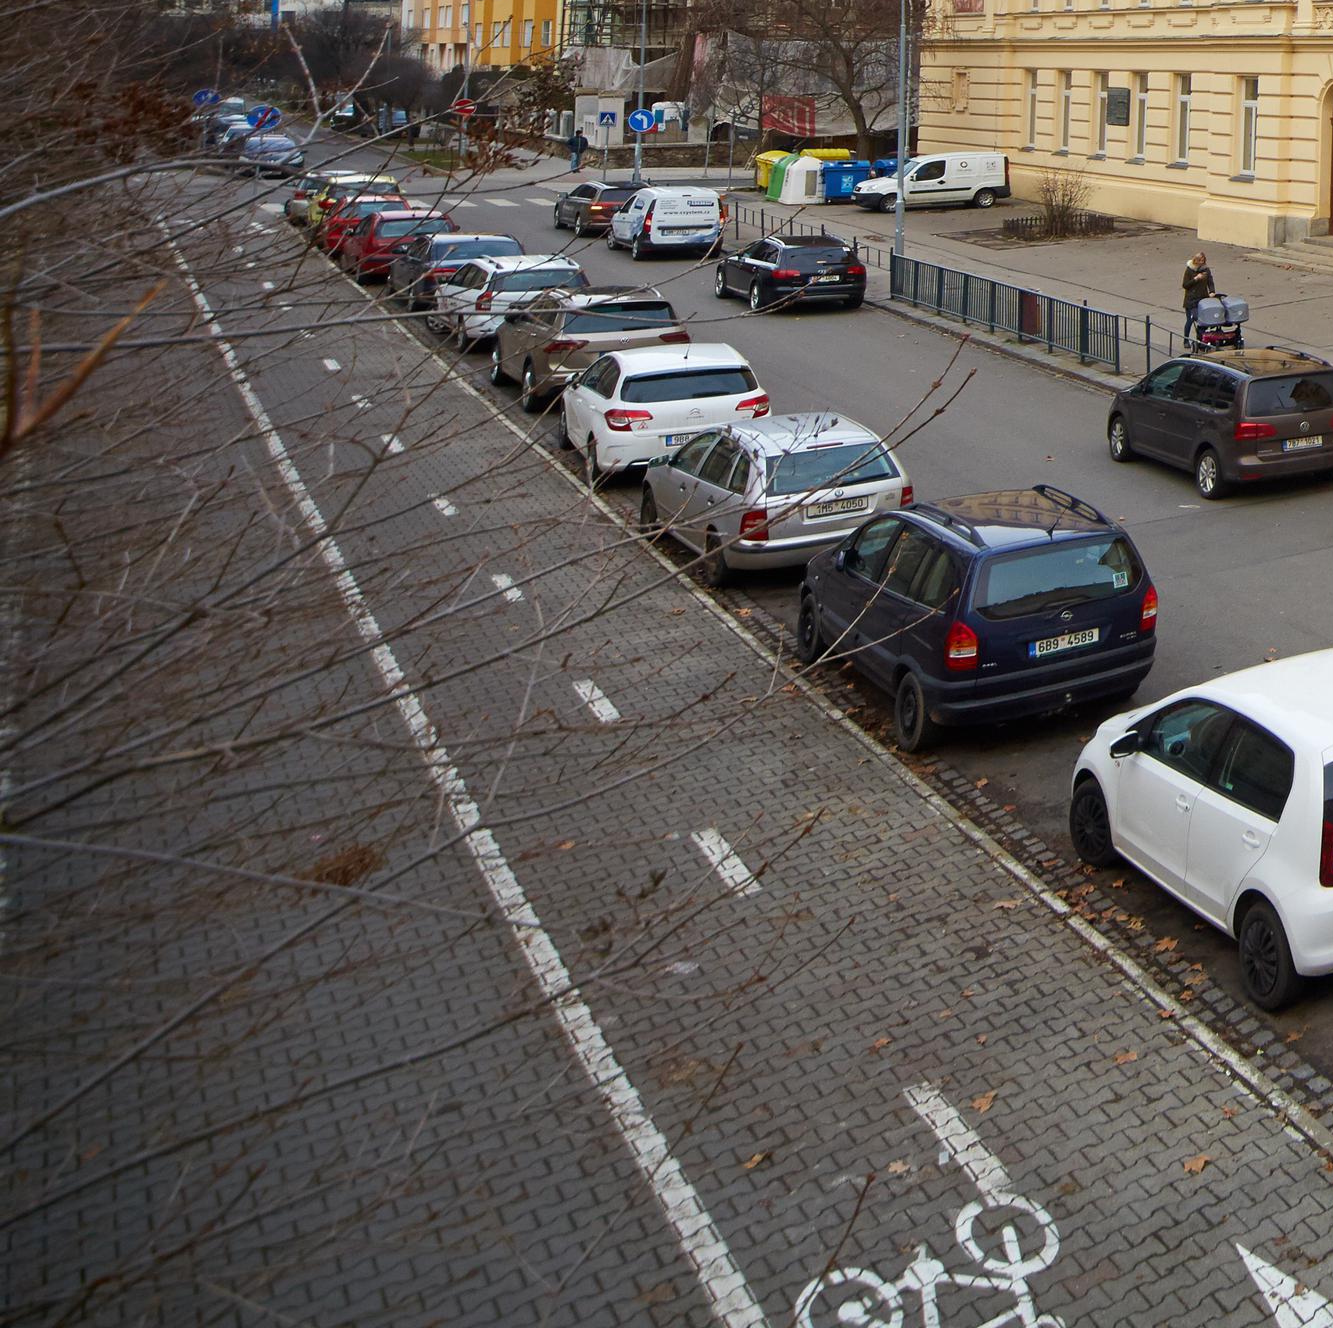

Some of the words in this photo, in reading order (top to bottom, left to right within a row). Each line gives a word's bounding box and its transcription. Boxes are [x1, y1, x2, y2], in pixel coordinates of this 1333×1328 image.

[840, 499, 863, 510] 4050
[1038, 638, 1059, 653] 6B9
[1067, 630, 1094, 646] 4589
